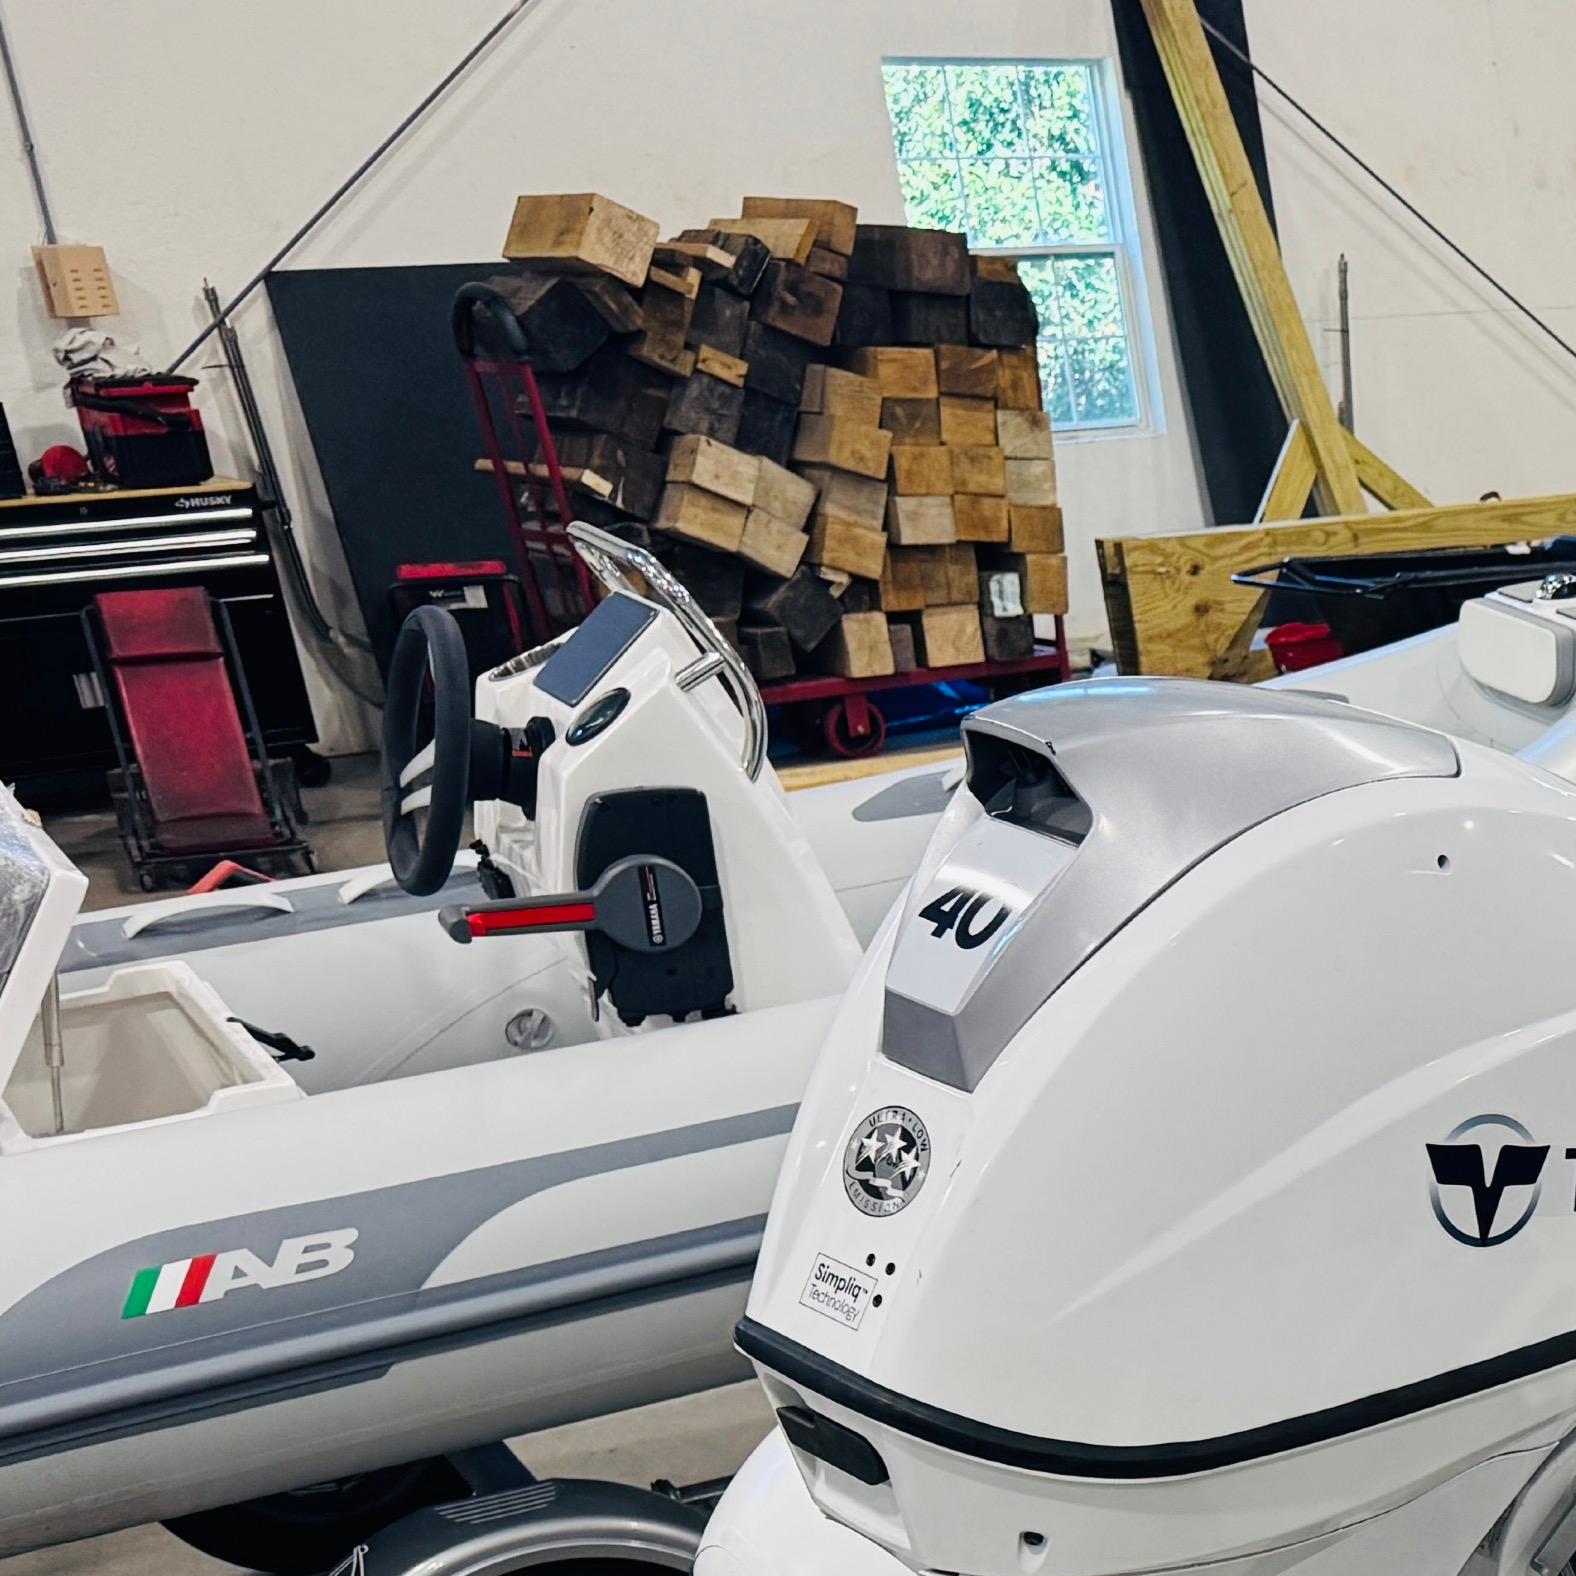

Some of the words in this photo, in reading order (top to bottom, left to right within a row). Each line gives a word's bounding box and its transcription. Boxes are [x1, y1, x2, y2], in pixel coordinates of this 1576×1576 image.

[190, 495, 232, 507] HUSKY
[918, 885, 1014, 950] 40
[199, 1227, 359, 1302] AB
